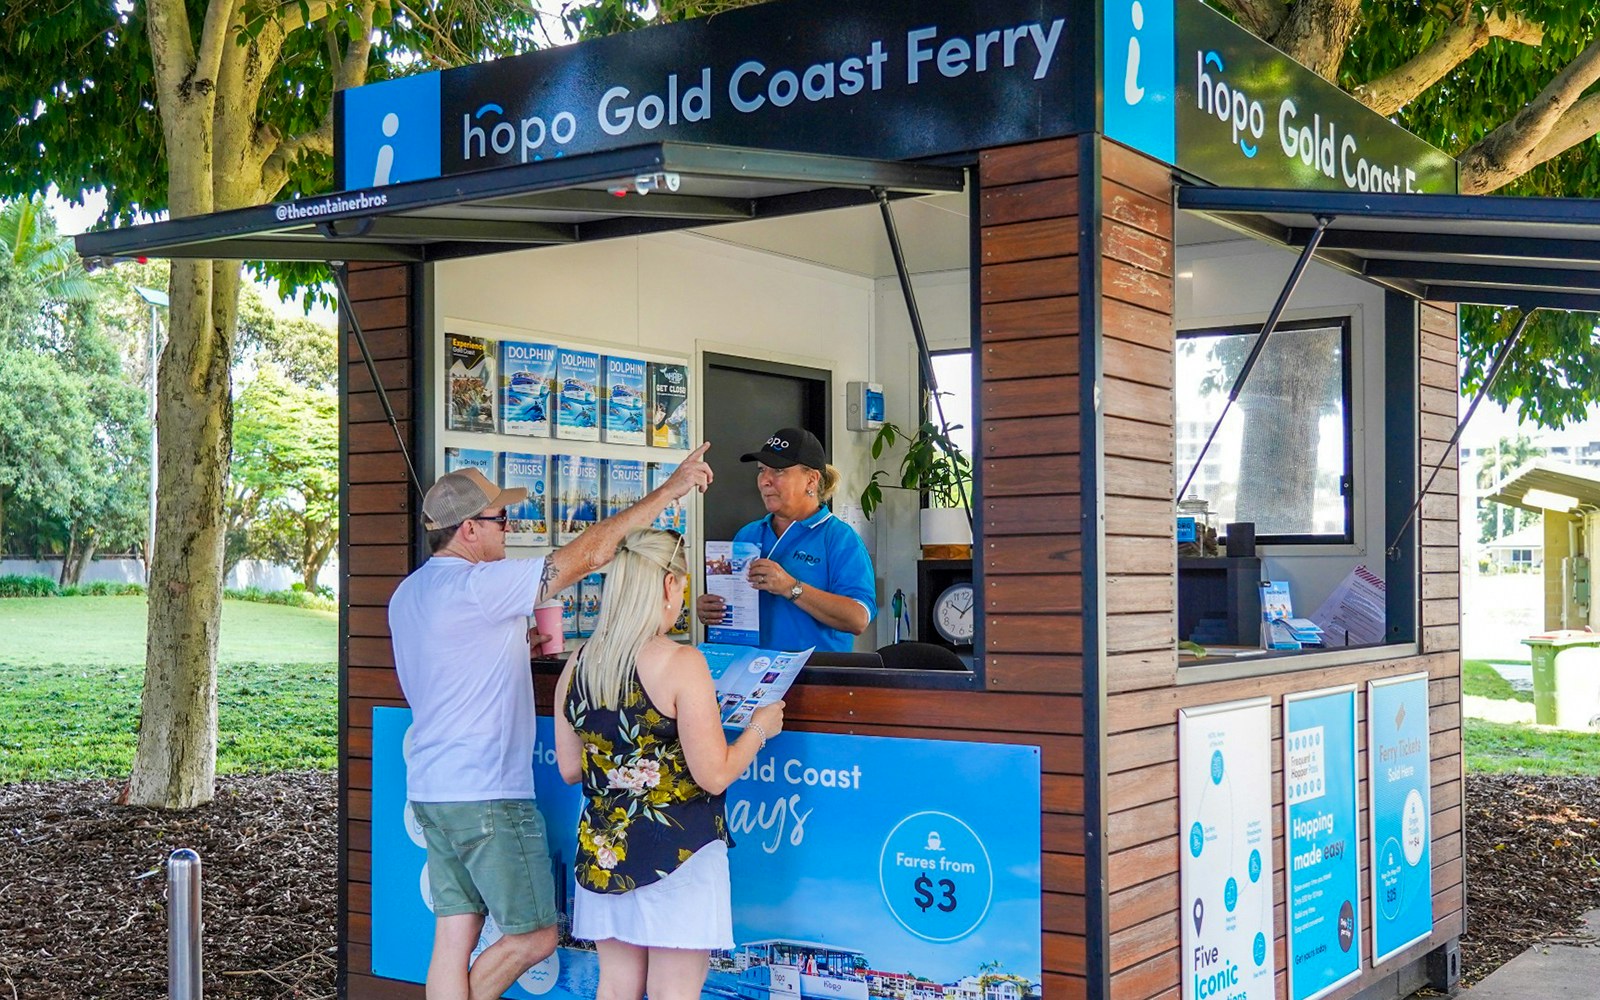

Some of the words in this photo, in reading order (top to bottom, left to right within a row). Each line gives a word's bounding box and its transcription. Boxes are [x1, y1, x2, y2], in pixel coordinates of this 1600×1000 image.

[464, 111, 577, 163] hopo
[598, 74, 711, 135] Gold
[728, 41, 890, 114] Coast
[907, 19, 1066, 84] Ferry
[1198, 50, 1264, 144] hopo
[1279, 99, 1335, 179] Gold
[1341, 134, 1400, 193] Coast
[276, 192, 388, 220] @thecontainerbros
[508, 346, 555, 361] DOLPHIN
[561, 353, 596, 369] DOLPHIN
[610, 360, 643, 375] DOLPHIN
[507, 463, 543, 476] CRUISES
[562, 465, 597, 479] CRUISES
[793, 550, 821, 563] hopo
[961, 592, 970, 600] 12
[944, 617, 949, 626] 8
[959, 628, 964, 636] 6
[1379, 744, 1398, 764] Ferry
[739, 757, 775, 782] old
[783, 759, 862, 789] Coast
[1293, 811, 1333, 841] Hopping
[896, 852, 936, 869] Fares
[939, 856, 975, 873] from
[1294, 843, 1322, 871] made
[1323, 840, 1345, 861] easy
[914, 872, 957, 913] $3
[1194, 945, 1219, 972] Five
[1194, 959, 1238, 1000] Iconic
